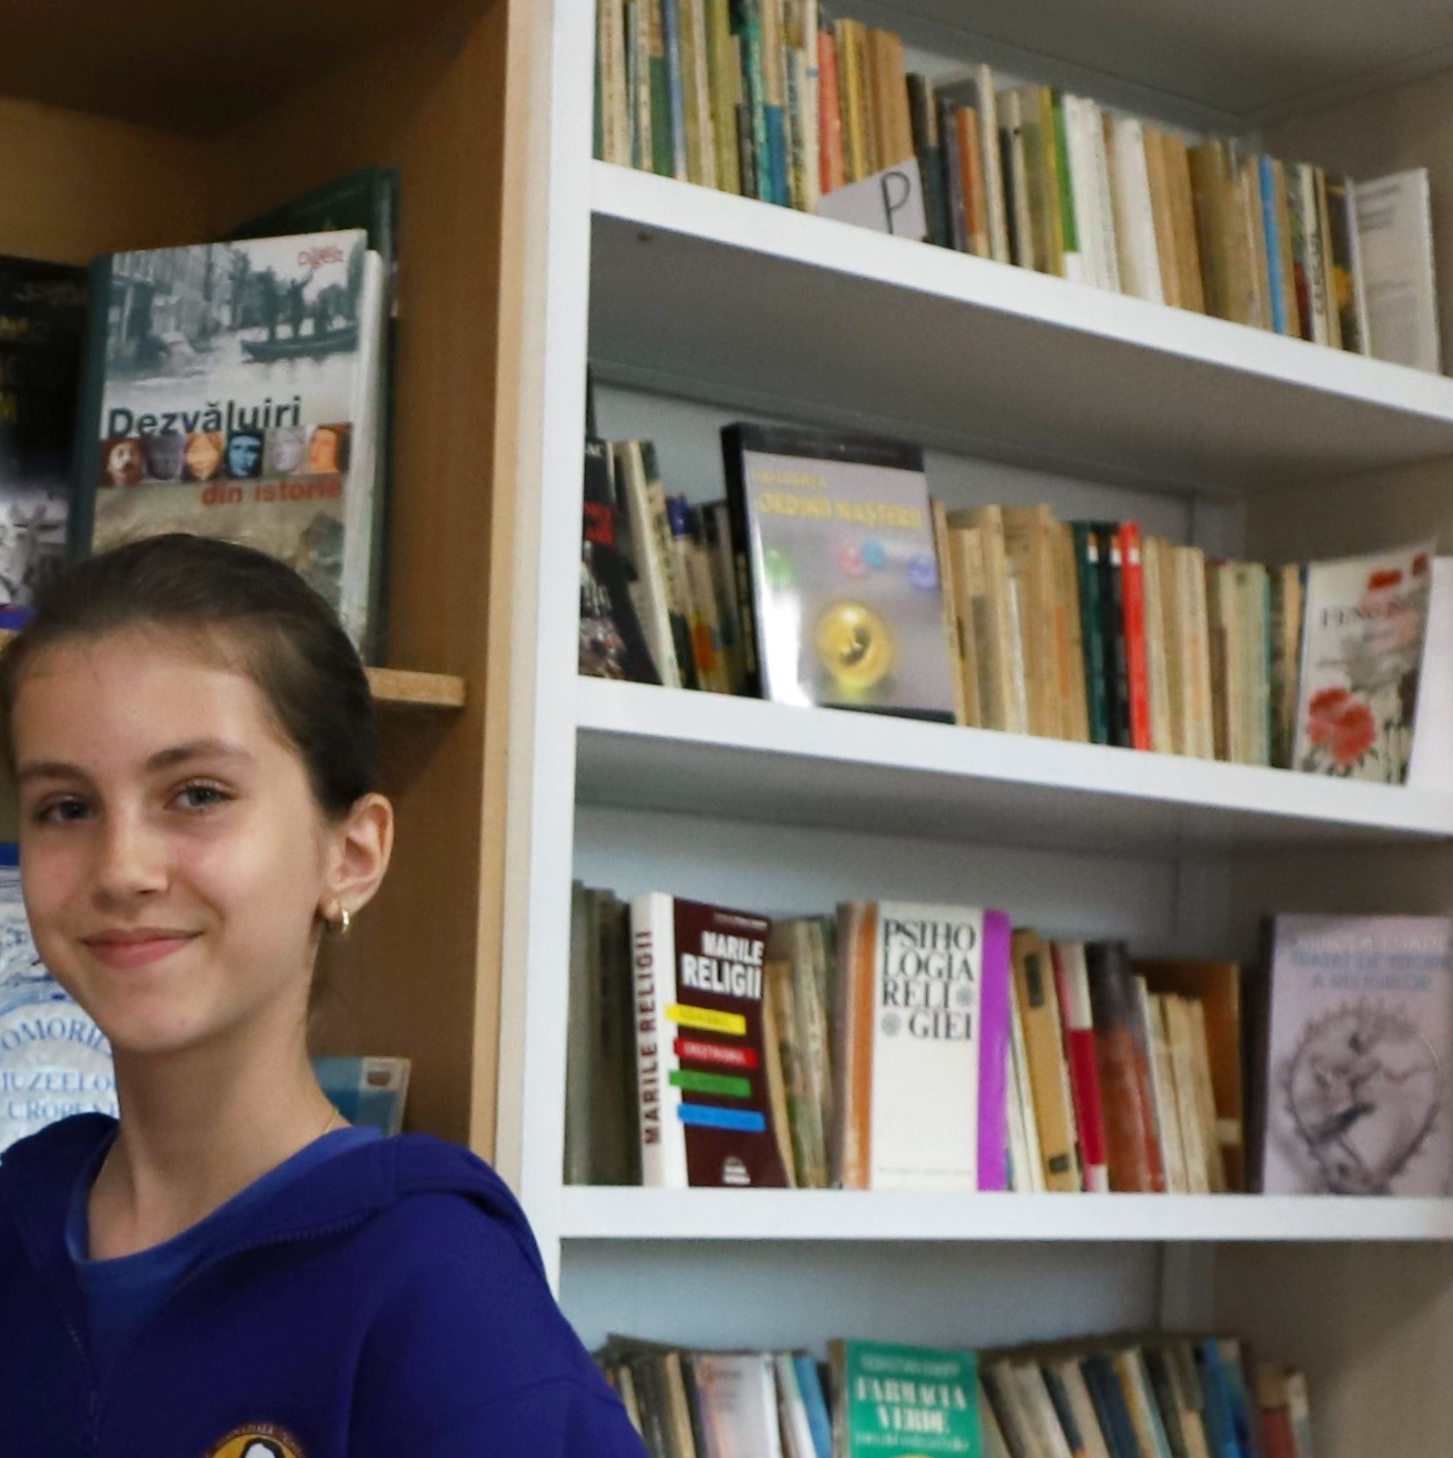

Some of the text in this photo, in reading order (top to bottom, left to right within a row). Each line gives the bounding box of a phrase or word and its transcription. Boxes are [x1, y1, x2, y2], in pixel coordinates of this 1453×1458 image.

[880, 169, 912, 235] P
[106, 396, 302, 438] Dezvăluiri
[201, 479, 343, 507] din istorie
[701, 930, 765, 967] MARILE
[882, 918, 976, 951] PSIHO
[680, 952, 764, 1001] RELIGII
[882, 951, 976, 982] LOGIA
[882, 980, 951, 1009] RELI
[635, 930, 663, 1145] MARILE RELIGII
[908, 1010, 974, 1041] GIEI
[856, 1376, 967, 1410] FARMACIA
